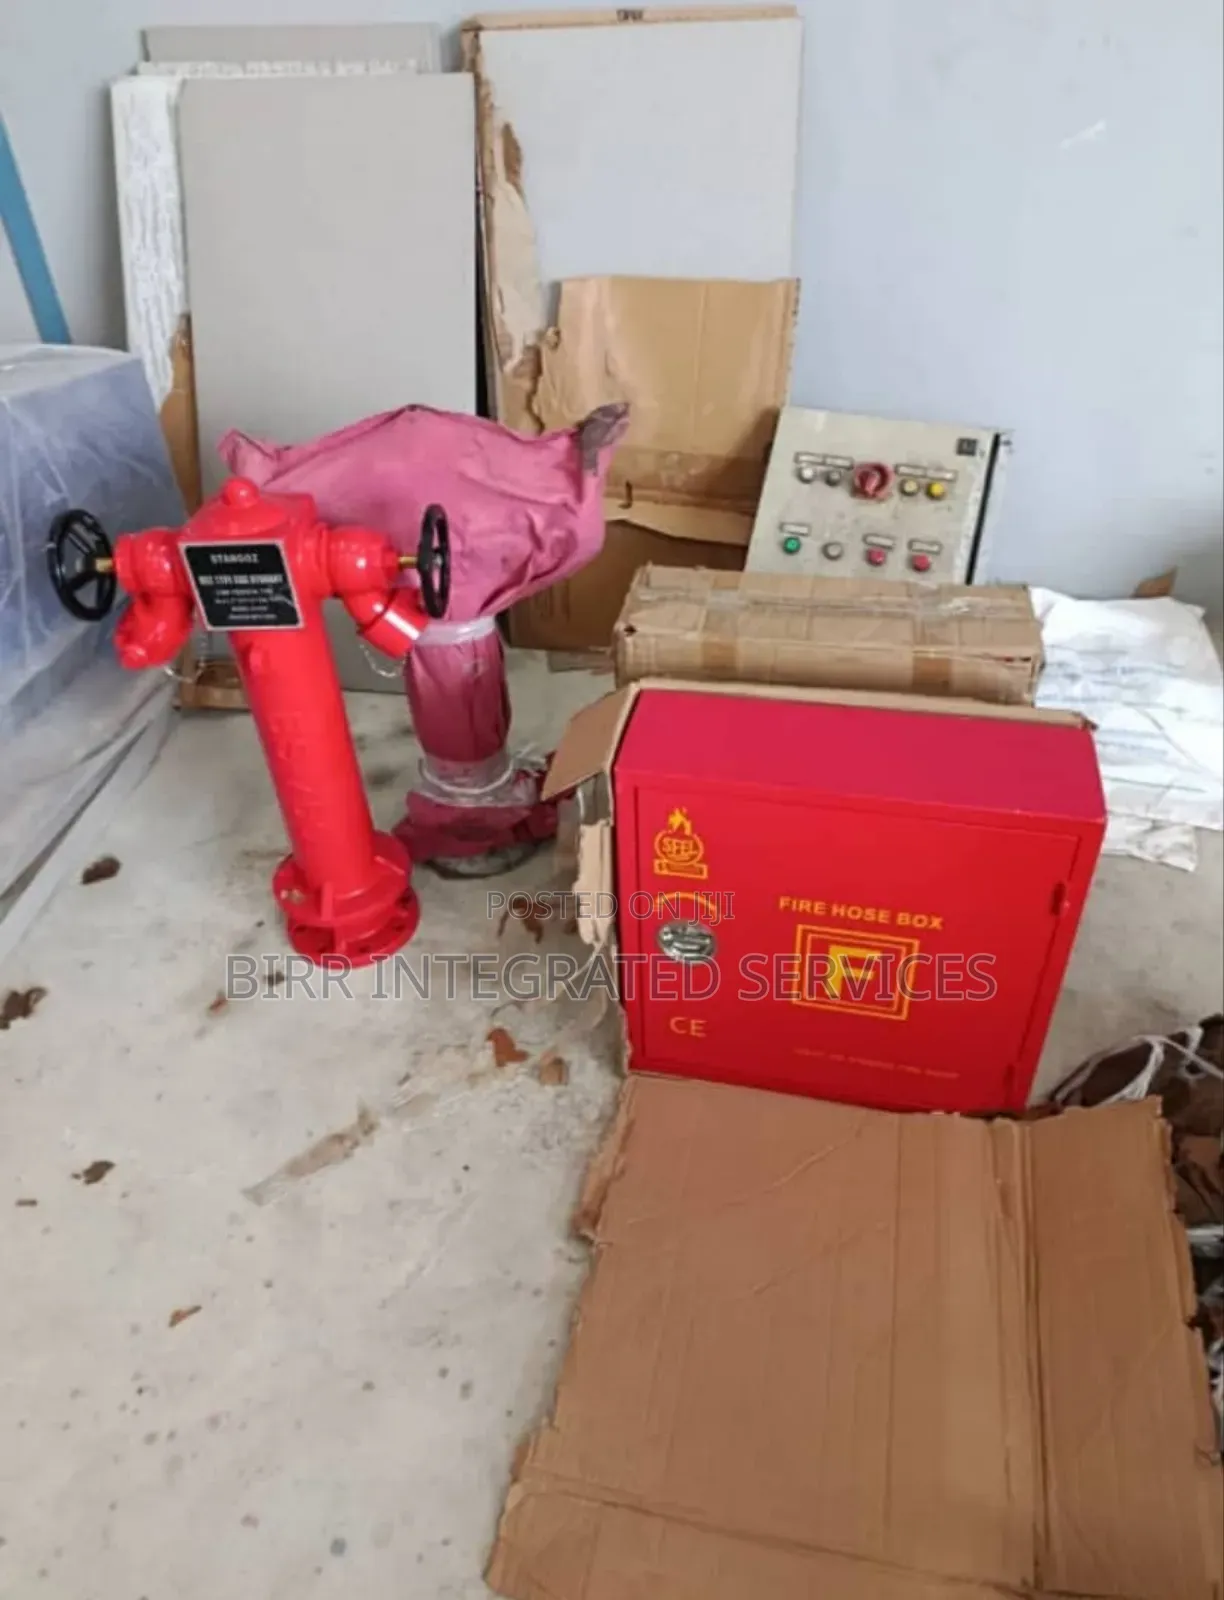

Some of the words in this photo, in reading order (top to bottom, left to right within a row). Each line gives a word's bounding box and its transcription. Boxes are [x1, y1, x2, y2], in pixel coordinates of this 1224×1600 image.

[779, 896, 828, 915] FIRE
[831, 904, 891, 924] HOSE
[896, 912, 944, 930] BOX
